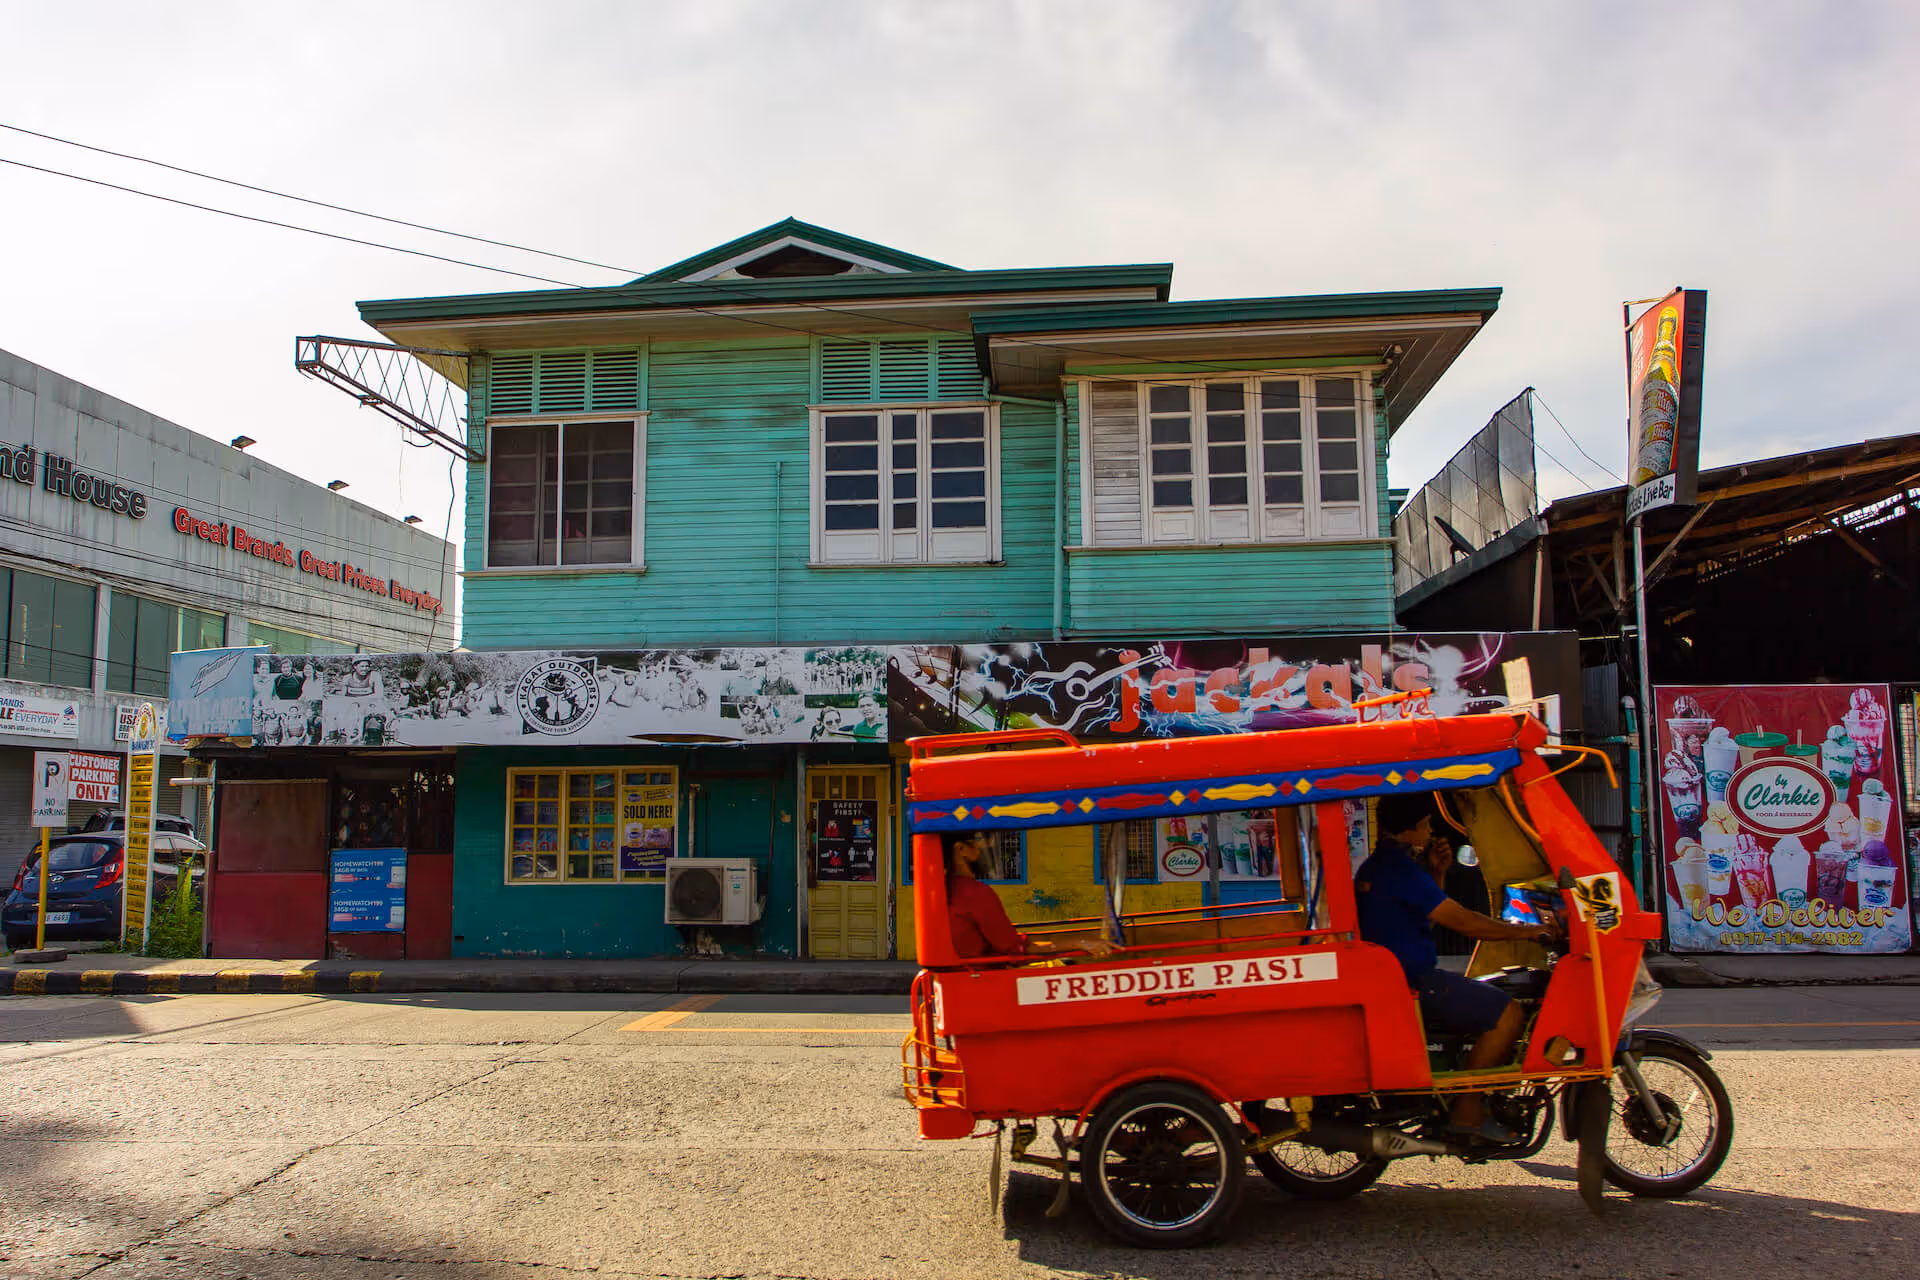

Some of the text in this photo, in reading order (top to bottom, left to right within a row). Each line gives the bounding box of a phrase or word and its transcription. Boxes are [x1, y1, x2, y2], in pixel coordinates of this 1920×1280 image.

[46, 452, 147, 519] House
[1643, 487, 1658, 508] Live
[1658, 480, 1674, 499] Bar
[174, 507, 229, 547] Great
[300, 550, 341, 581] Great
[520, 662, 597, 700] KAGAY OUTDOORS
[1110, 641, 1430, 732] jackals
[15, 712, 58, 725] EVERYDAY
[70, 754, 119, 770] CUSTOMER
[72, 768, 116, 783] PARKING
[1775, 774, 1788, 789] by
[76, 783, 109, 801] ONLY
[1744, 784, 1819, 810] Clarkie
[45, 797, 56, 806] NO
[34, 807, 66, 816] PARKING
[624, 805, 646, 818] SOLD
[648, 805, 673, 818] HERE!
[1691, 897, 1895, 928] We Deliver
[1719, 931, 1863, 946] 0917-114-2982
[1045, 967, 1194, 1000] FREDDIE
